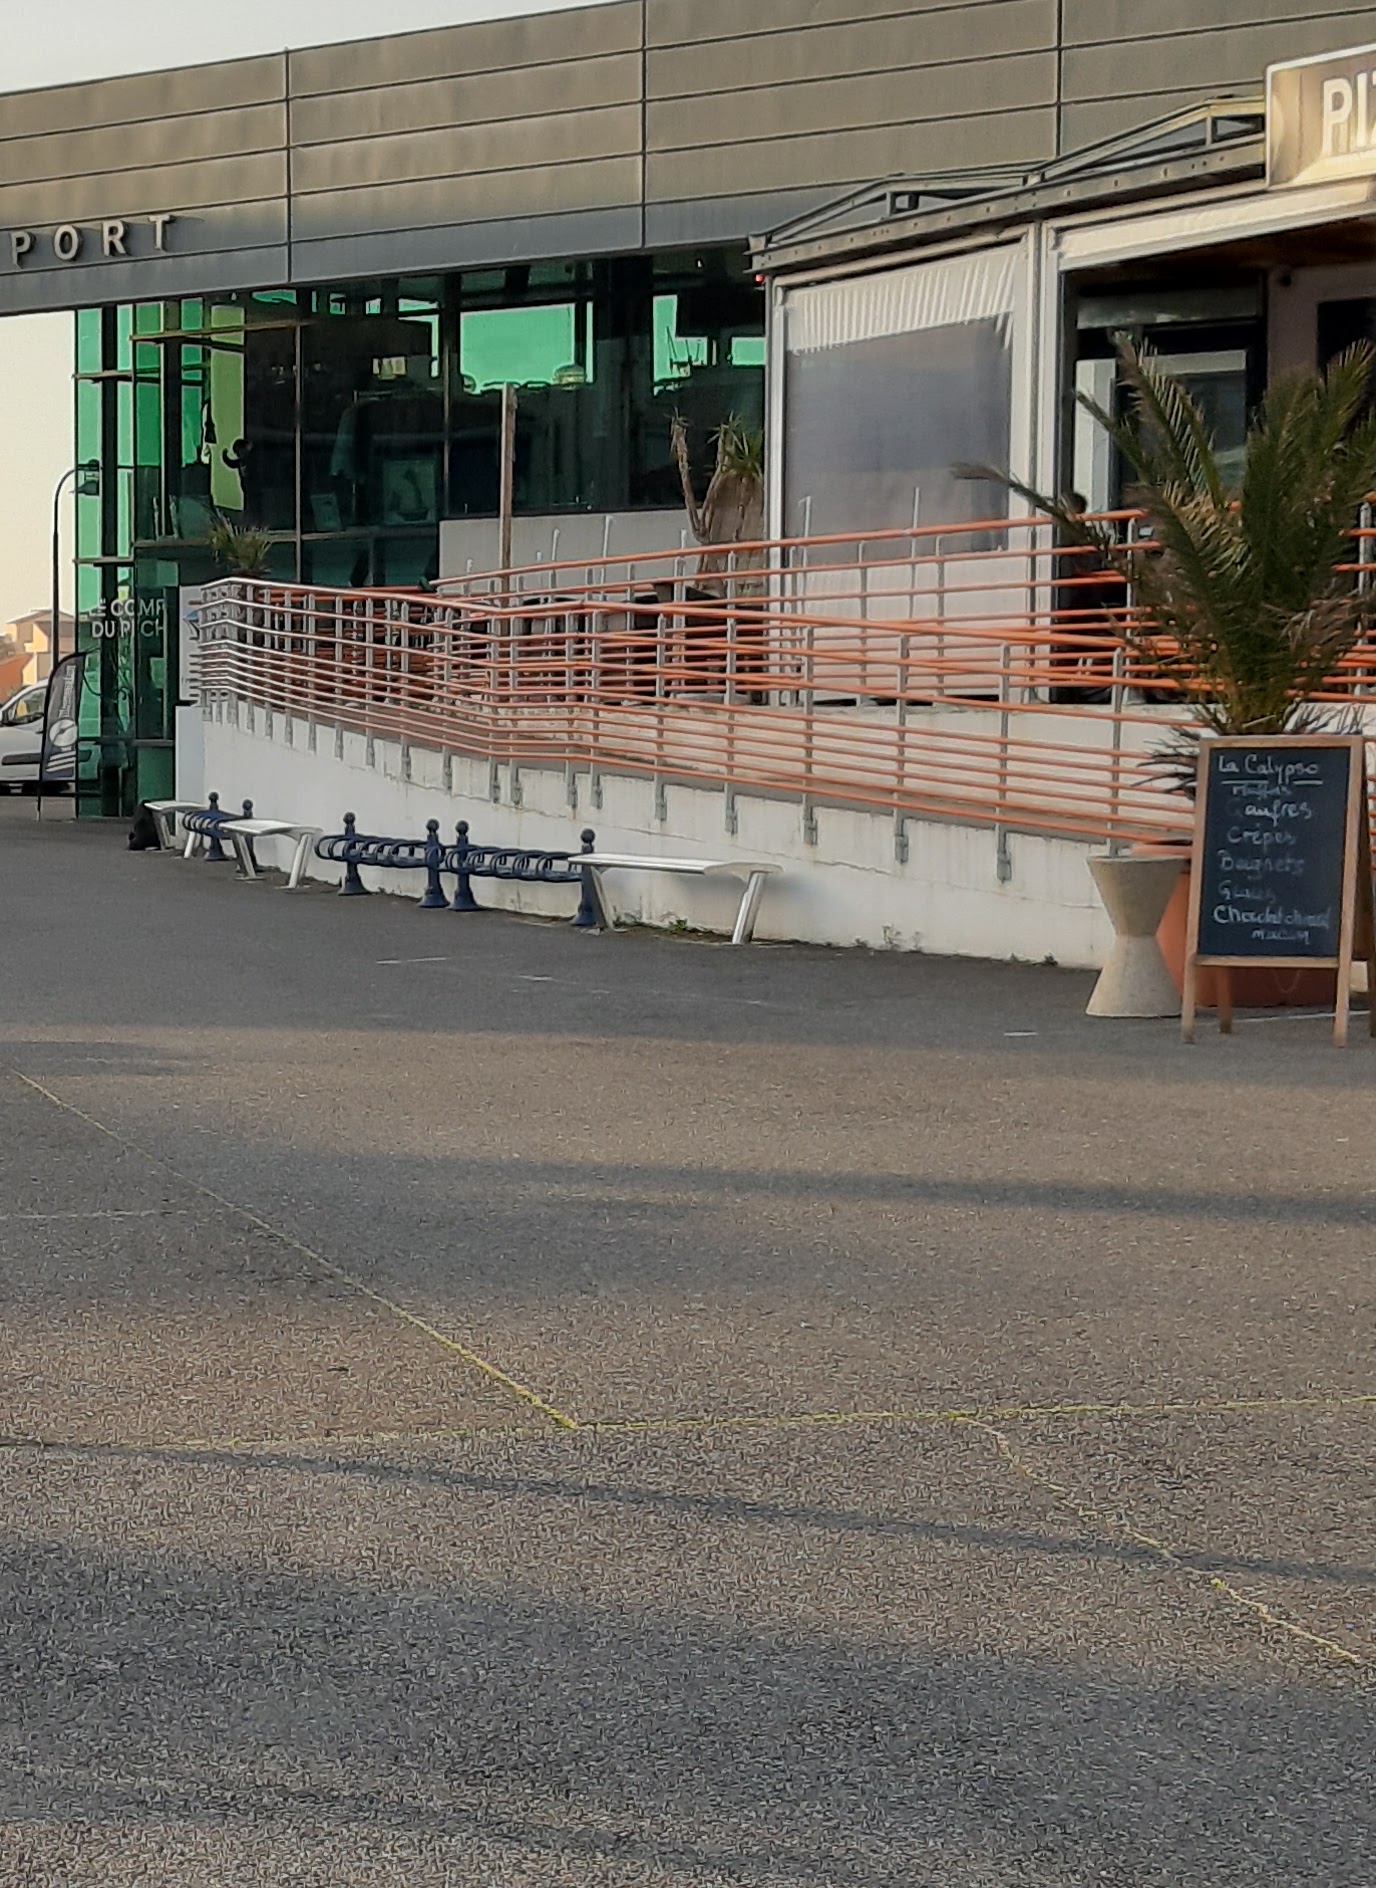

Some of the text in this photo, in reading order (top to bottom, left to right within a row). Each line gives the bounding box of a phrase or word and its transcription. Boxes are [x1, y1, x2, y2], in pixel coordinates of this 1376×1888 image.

[1321, 71, 1376, 154] PI
[10, 215, 173, 269] PORT
[92, 620, 115, 638] DU
[1219, 753, 1319, 785] La Calypso
